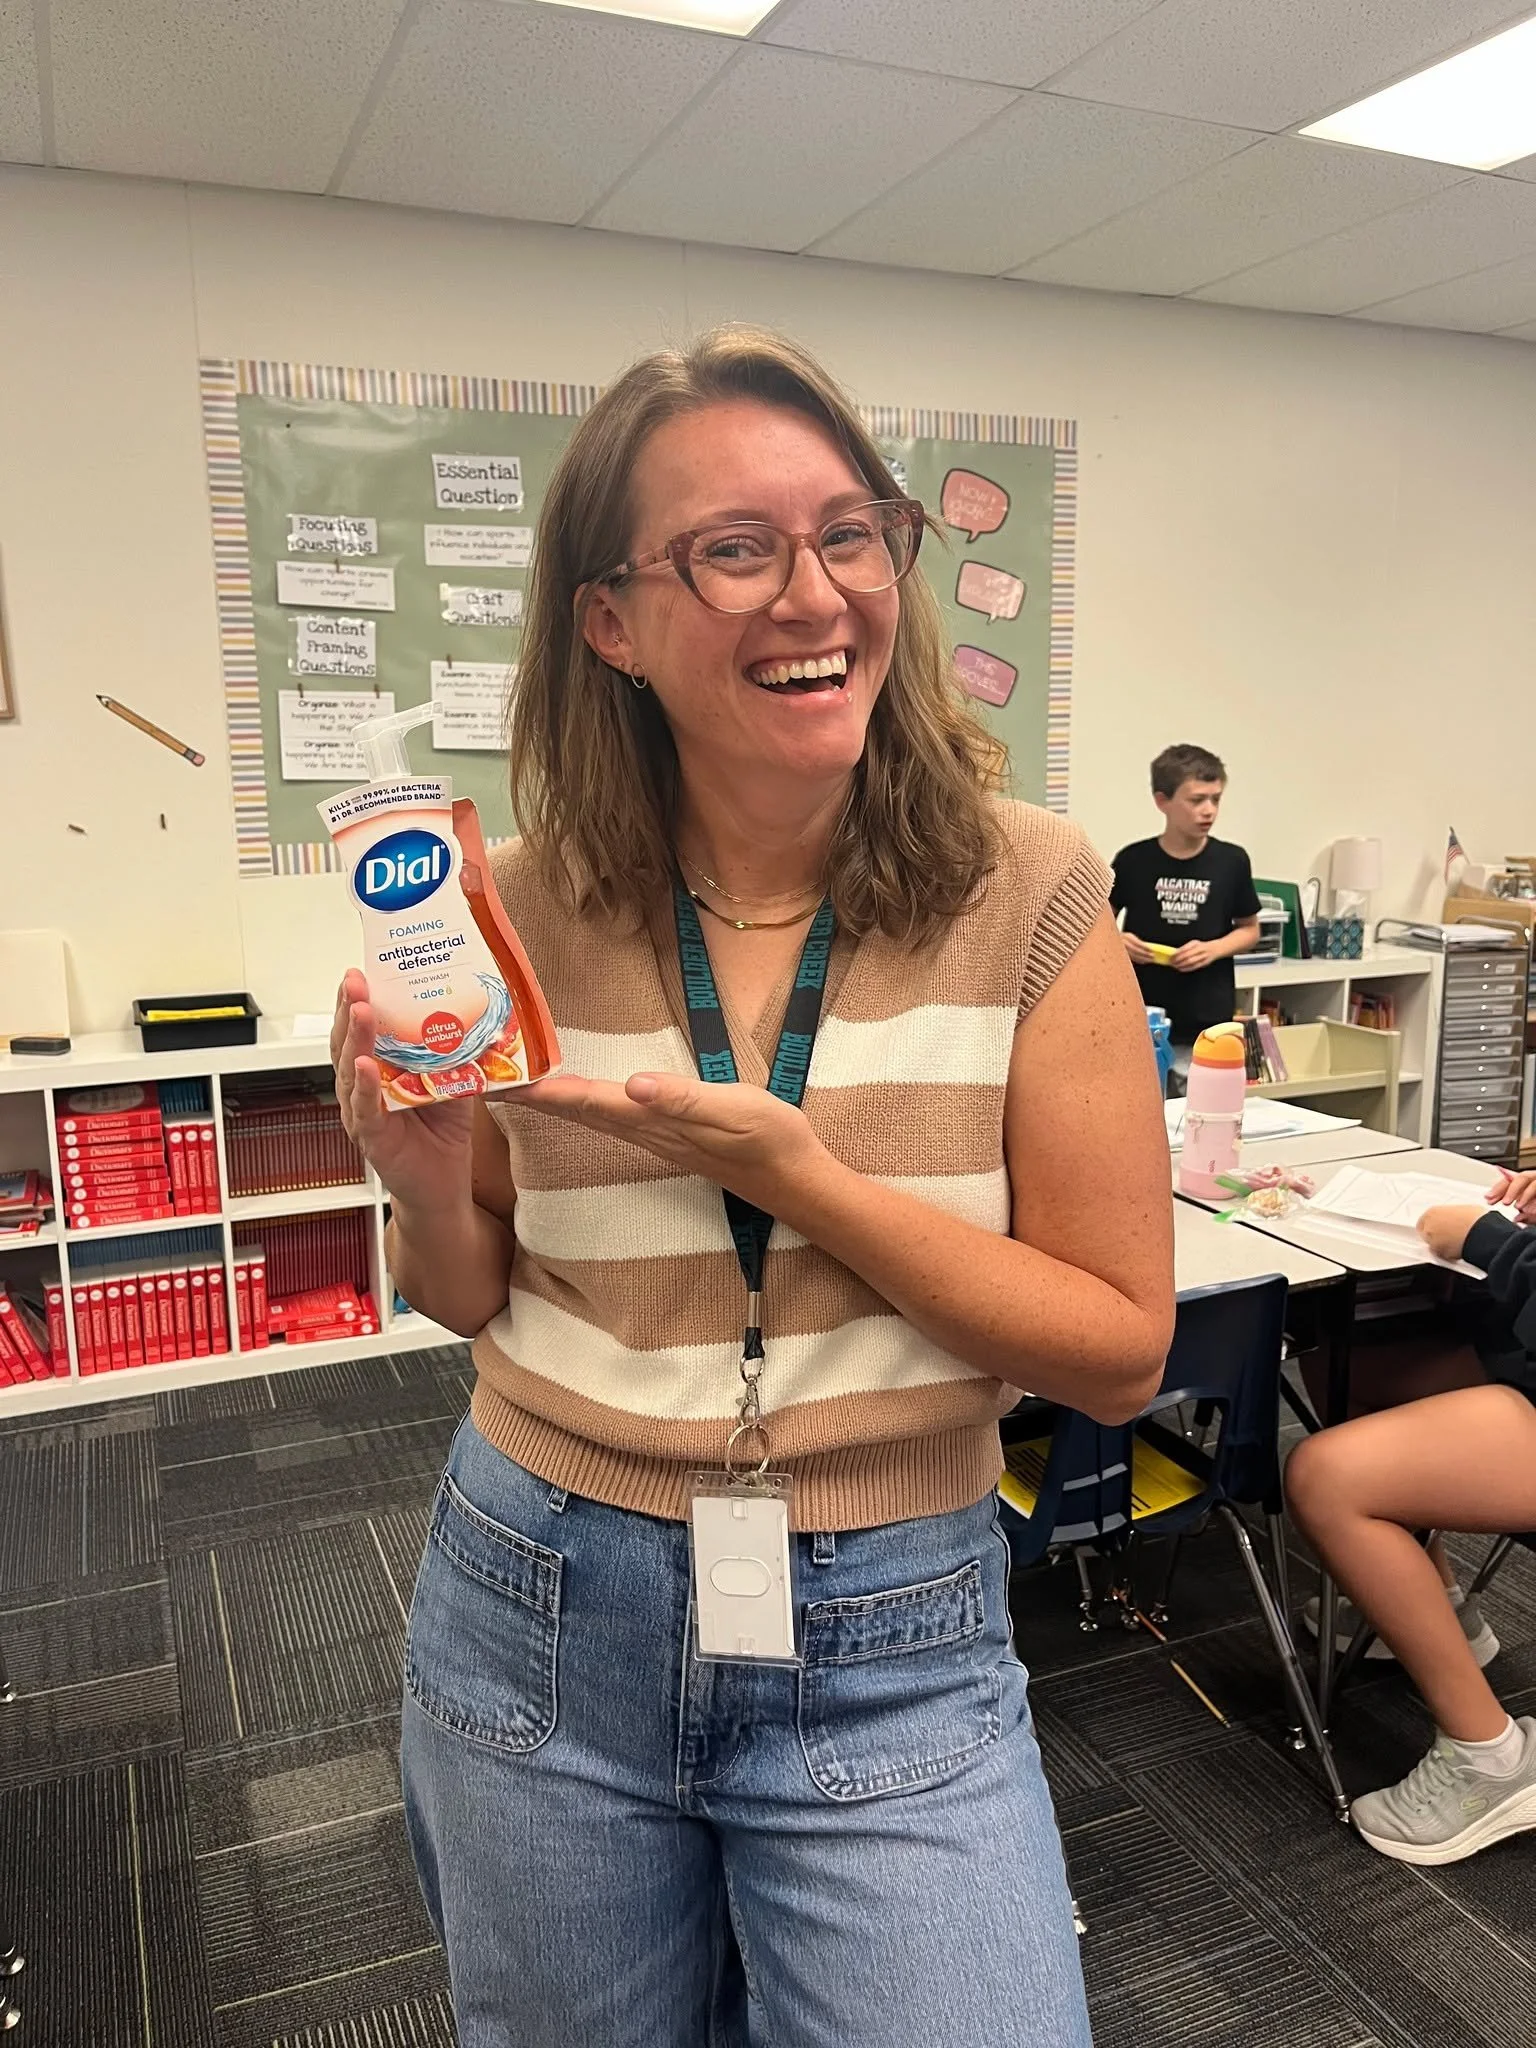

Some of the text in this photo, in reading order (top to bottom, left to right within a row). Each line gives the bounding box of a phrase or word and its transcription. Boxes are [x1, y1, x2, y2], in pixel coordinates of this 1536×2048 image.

[436, 462, 519, 480] Essential
[440, 487, 518, 504] Question
[296, 537, 373, 553] Questions
[307, 620, 366, 636] Content
[307, 640, 369, 659] Framing
[300, 659, 376, 676] Questions
[328, 800, 351, 814] KILLS
[362, 789, 390, 800] 99.99%
[391, 786, 400, 794] of
[401, 784, 441, 792] BACTERIA
[331, 814, 341, 823] #1
[341, 810, 355, 818] DR.
[354, 795, 413, 814] RECOMMENDED
[366, 845, 440, 895] Dial
[1155, 877, 1211, 891] ALCATRAZ
[1157, 890, 1207, 904] PSYCHO
[1161, 900, 1197, 912] WARD
[389, 919, 444, 939] FOAMING
[378, 934, 466, 961] antibacterial
[398, 951, 451, 971] defense
[795, 940, 830, 989] CREEK
[408, 973, 450, 986] HAND WASH
[681, 943, 719, 1009] BOULDER
[420, 988, 445, 1000] aloe
[426, 1022, 457, 1034] citrus
[424, 1029, 463, 1044] sunburst
[700, 1049, 737, 1083] EEK
[768, 1031, 813, 1104] BOULDER
[87, 1120, 129, 1130] Dictionary
[88, 1133, 130, 1144] Dictionary
[90, 1146, 132, 1157] Dictionary
[90, 1161, 132, 1171] Dictionary
[94, 1174, 136, 1185] Dictionary
[97, 1187, 139, 1197] Dictionary
[94, 1200, 137, 1211] Dictionary
[100, 1214, 142, 1225] Dictionary
